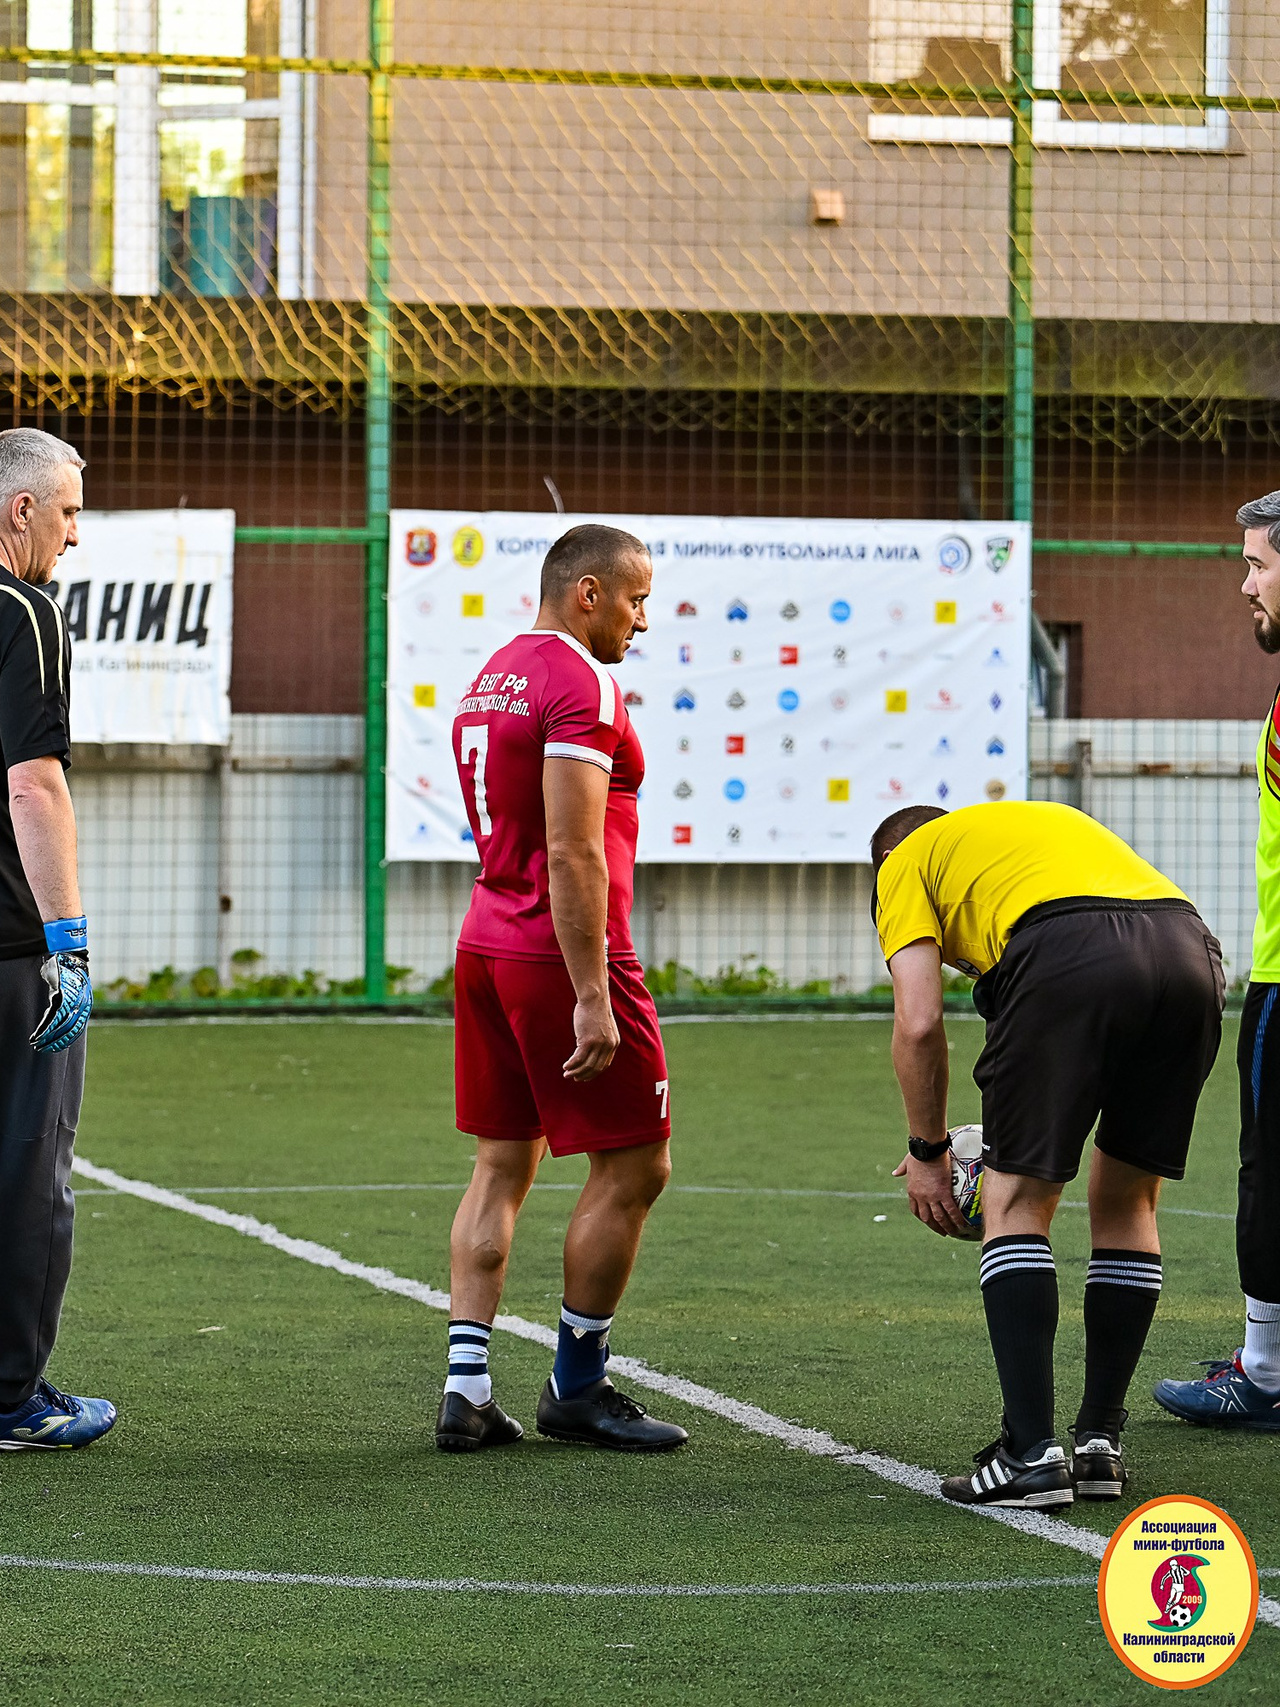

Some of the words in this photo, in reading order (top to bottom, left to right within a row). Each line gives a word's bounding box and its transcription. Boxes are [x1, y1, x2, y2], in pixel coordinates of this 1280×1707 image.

[873, 544, 921, 562] ЛИГА
[476, 673, 504, 693] ВНГ
[500, 673, 528, 694] РФ
[461, 724, 492, 836] 7
[655, 1079, 669, 1119] 7
